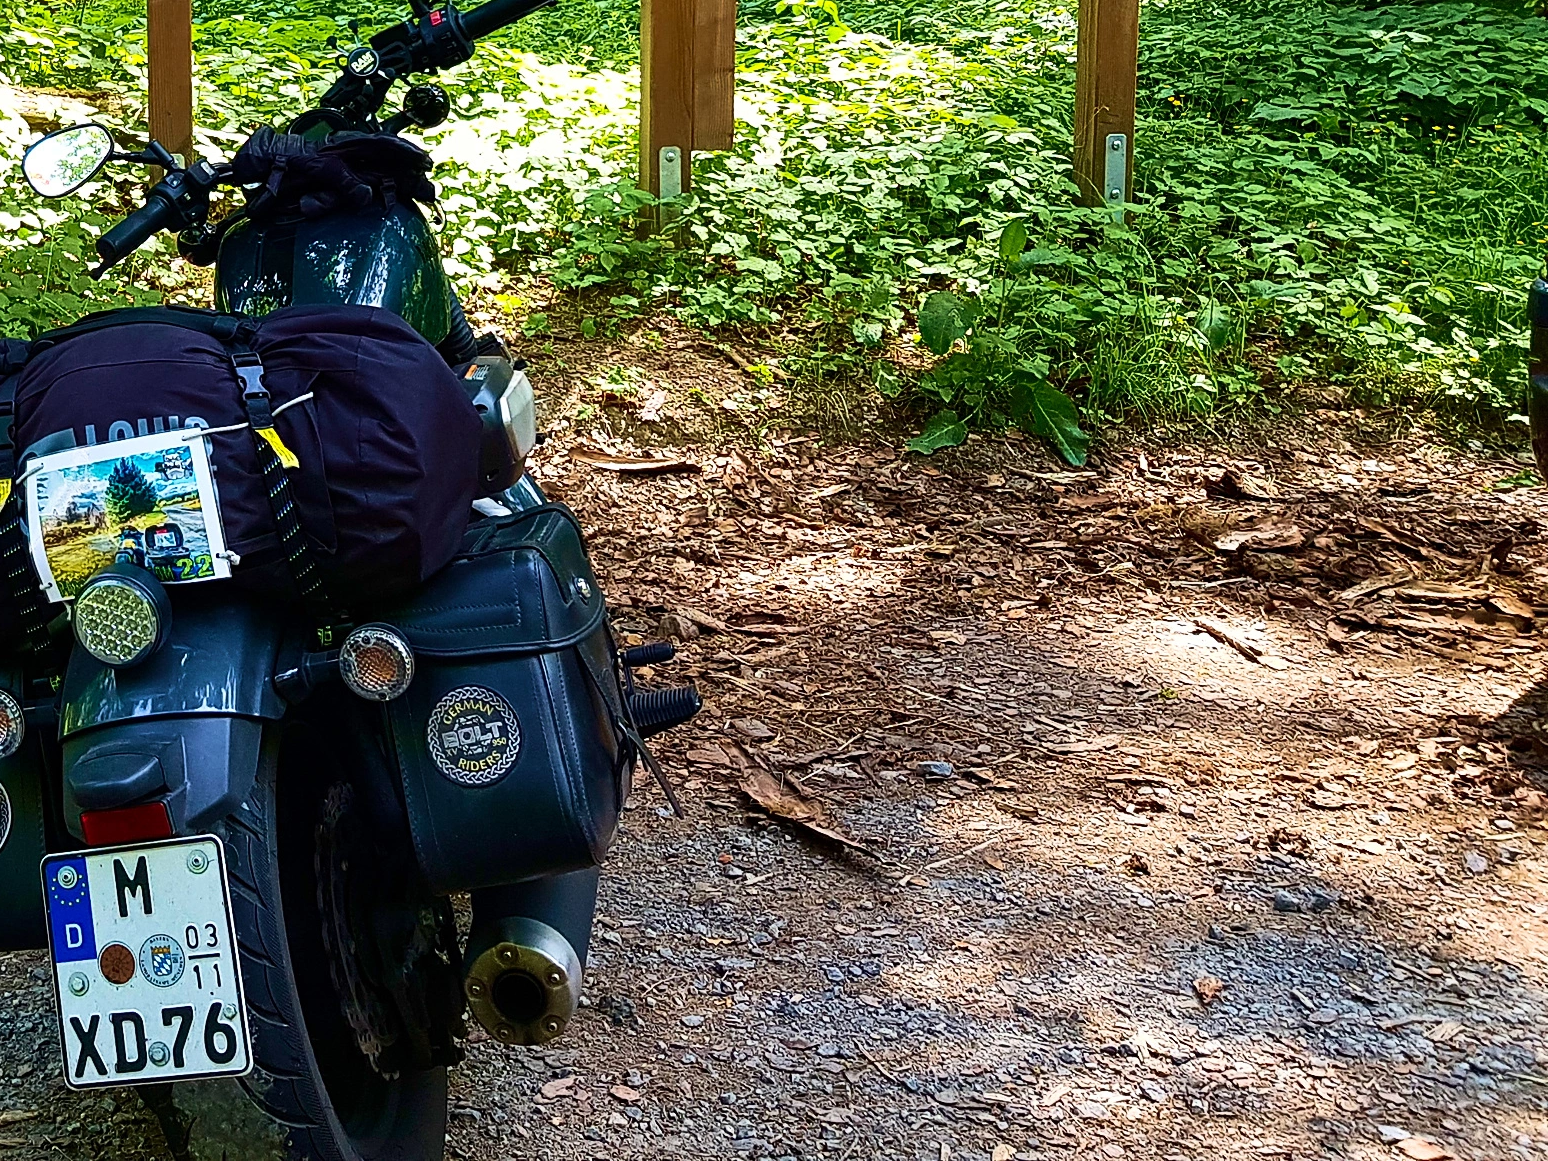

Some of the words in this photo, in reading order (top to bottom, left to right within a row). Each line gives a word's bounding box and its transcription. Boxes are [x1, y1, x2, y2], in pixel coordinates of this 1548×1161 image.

[351, 51, 375, 73] RAM
[176, 554, 214, 579] 22
[443, 700, 494, 724] GERMAN
[442, 722, 503, 748] BOLT
[492, 737, 507, 747] 950
[458, 750, 501, 771] RIDERS
[112, 855, 153, 918] M
[65, 923, 83, 948] D
[185, 923, 218, 950] 03
[193, 963, 222, 989] 11
